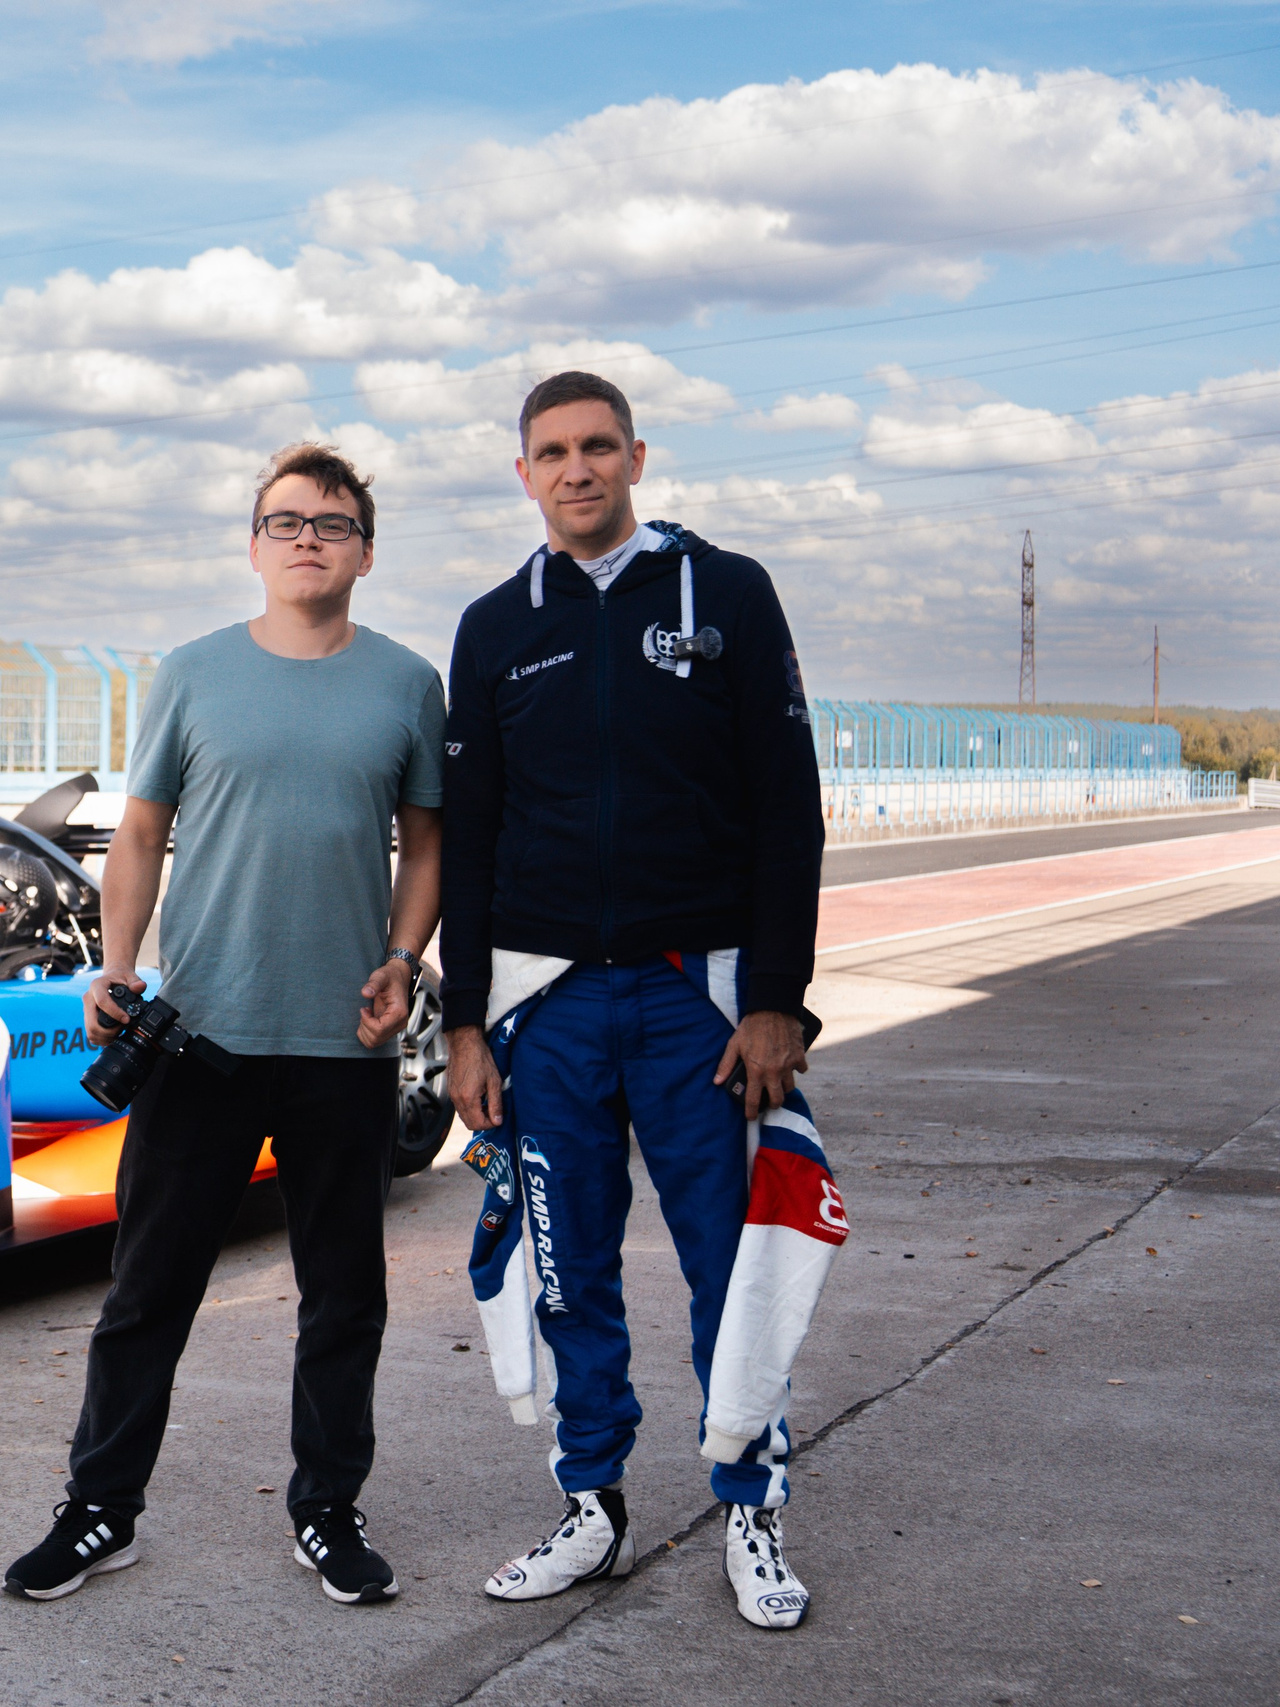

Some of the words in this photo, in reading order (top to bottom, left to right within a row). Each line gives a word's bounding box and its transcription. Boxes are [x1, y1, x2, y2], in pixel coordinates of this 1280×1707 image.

[520, 663, 540, 676] SMP
[541, 651, 574, 669] RACING
[445, 741, 463, 756] ТО
[10, 1031, 46, 1060] MP
[527, 1171, 551, 1232] SMP
[813, 1220, 848, 1237] ENGINEE
